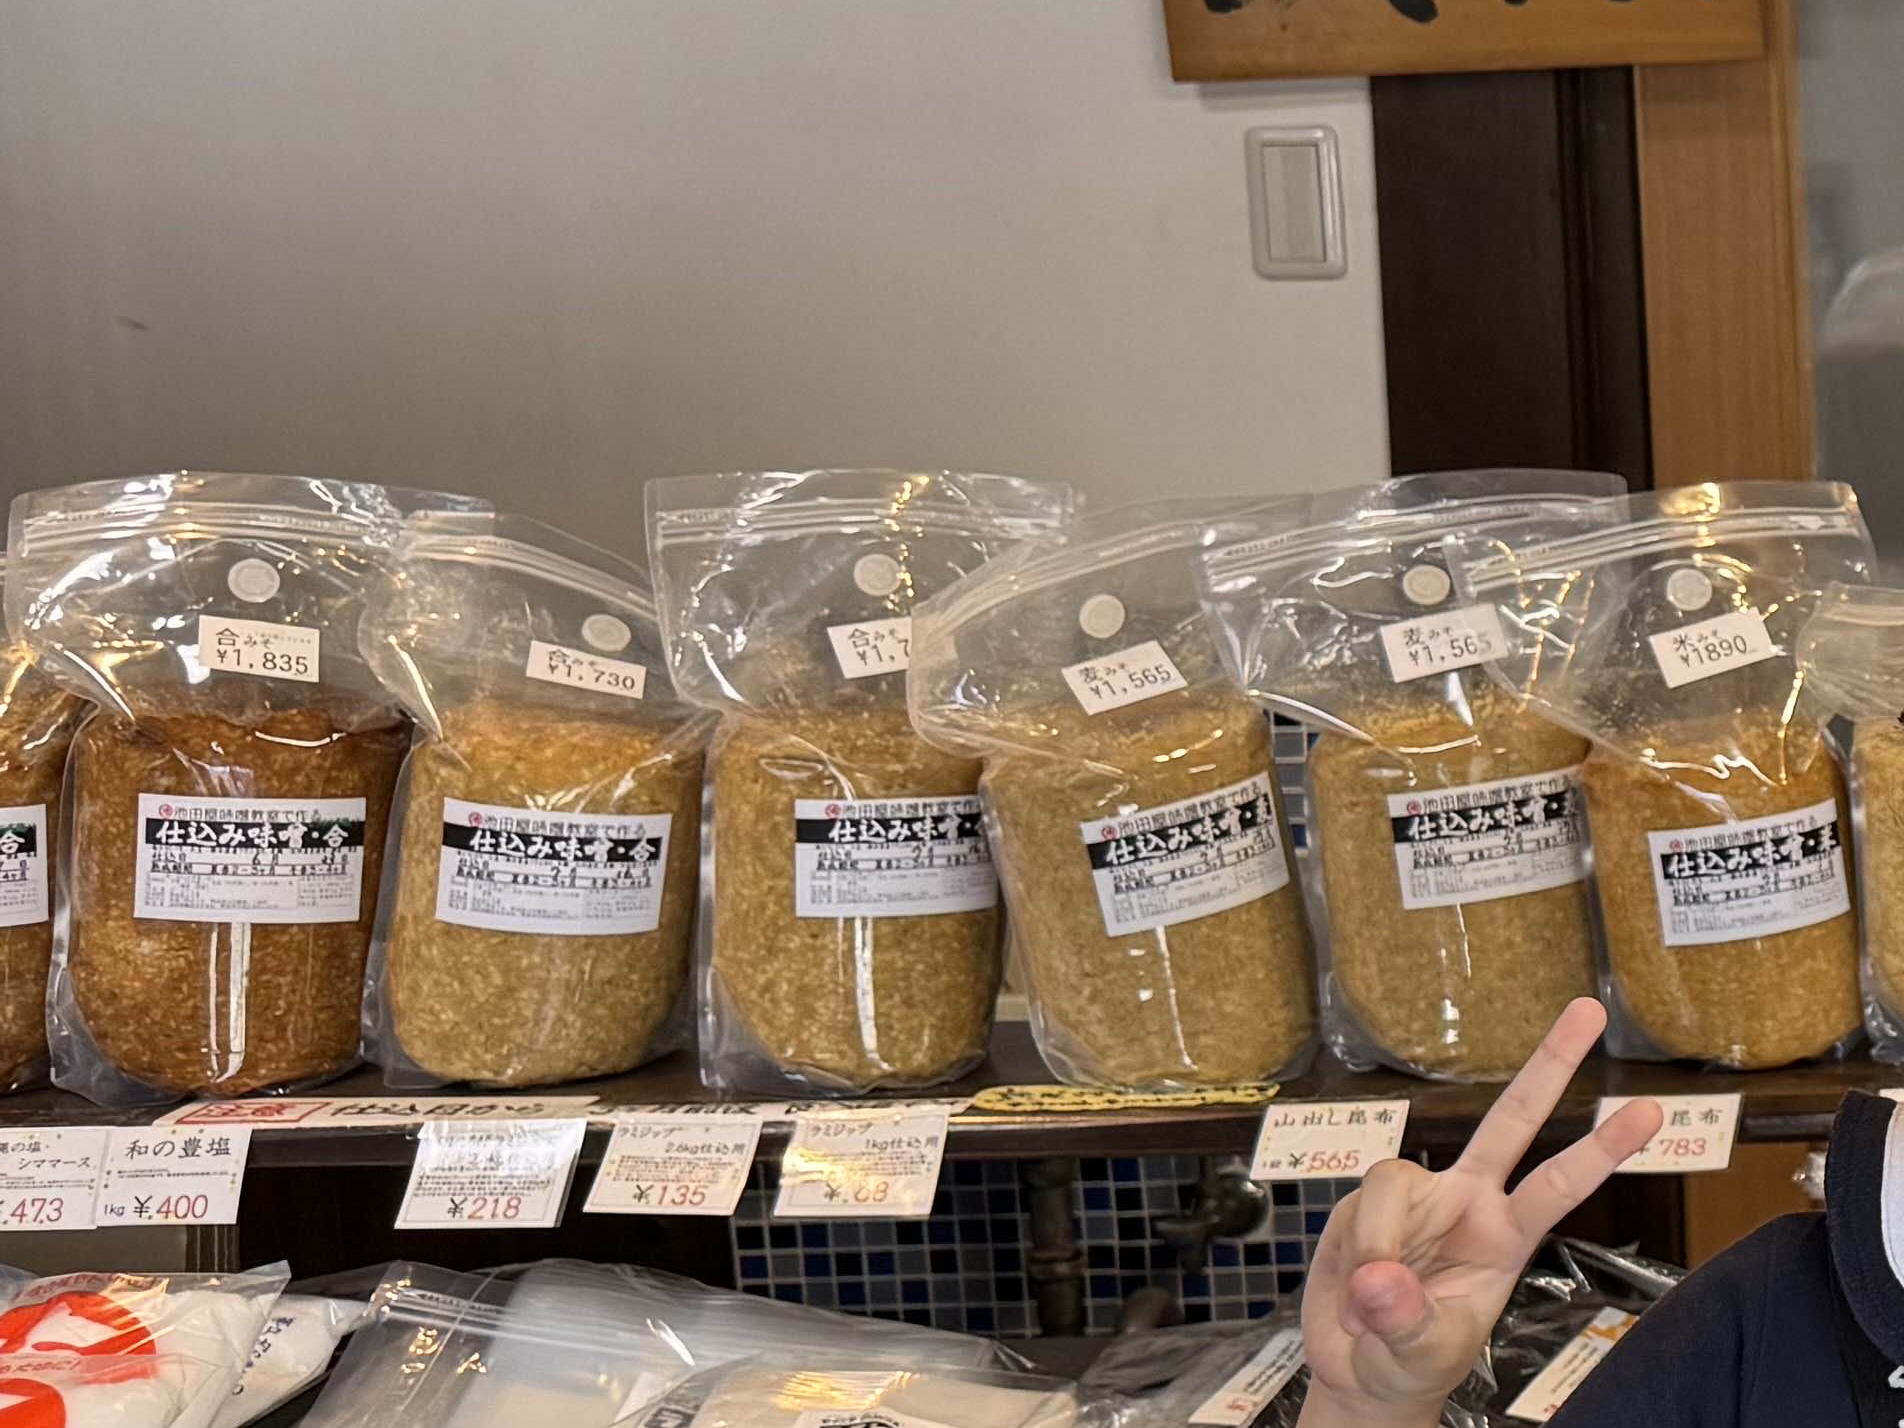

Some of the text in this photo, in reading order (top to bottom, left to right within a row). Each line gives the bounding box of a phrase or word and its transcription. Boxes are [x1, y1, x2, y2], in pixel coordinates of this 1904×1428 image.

[216, 648, 309, 674] ¥1,835
[548, 663, 635, 691] ¥1,730
[1090, 664, 1171, 700] ¥1,565
[1272, 1105, 1395, 1132] 山出し昆布
[125, 1138, 233, 1159] 和の豊塩
[1288, 1147, 1360, 1172] ¥565
[19, 1155, 92, 1170] シママース
[133, 1195, 208, 1221] ¥400
[447, 1194, 523, 1221] ¥218
[633, 1184, 707, 1208] ¥135
[0, 1198, 64, 1224] 473
